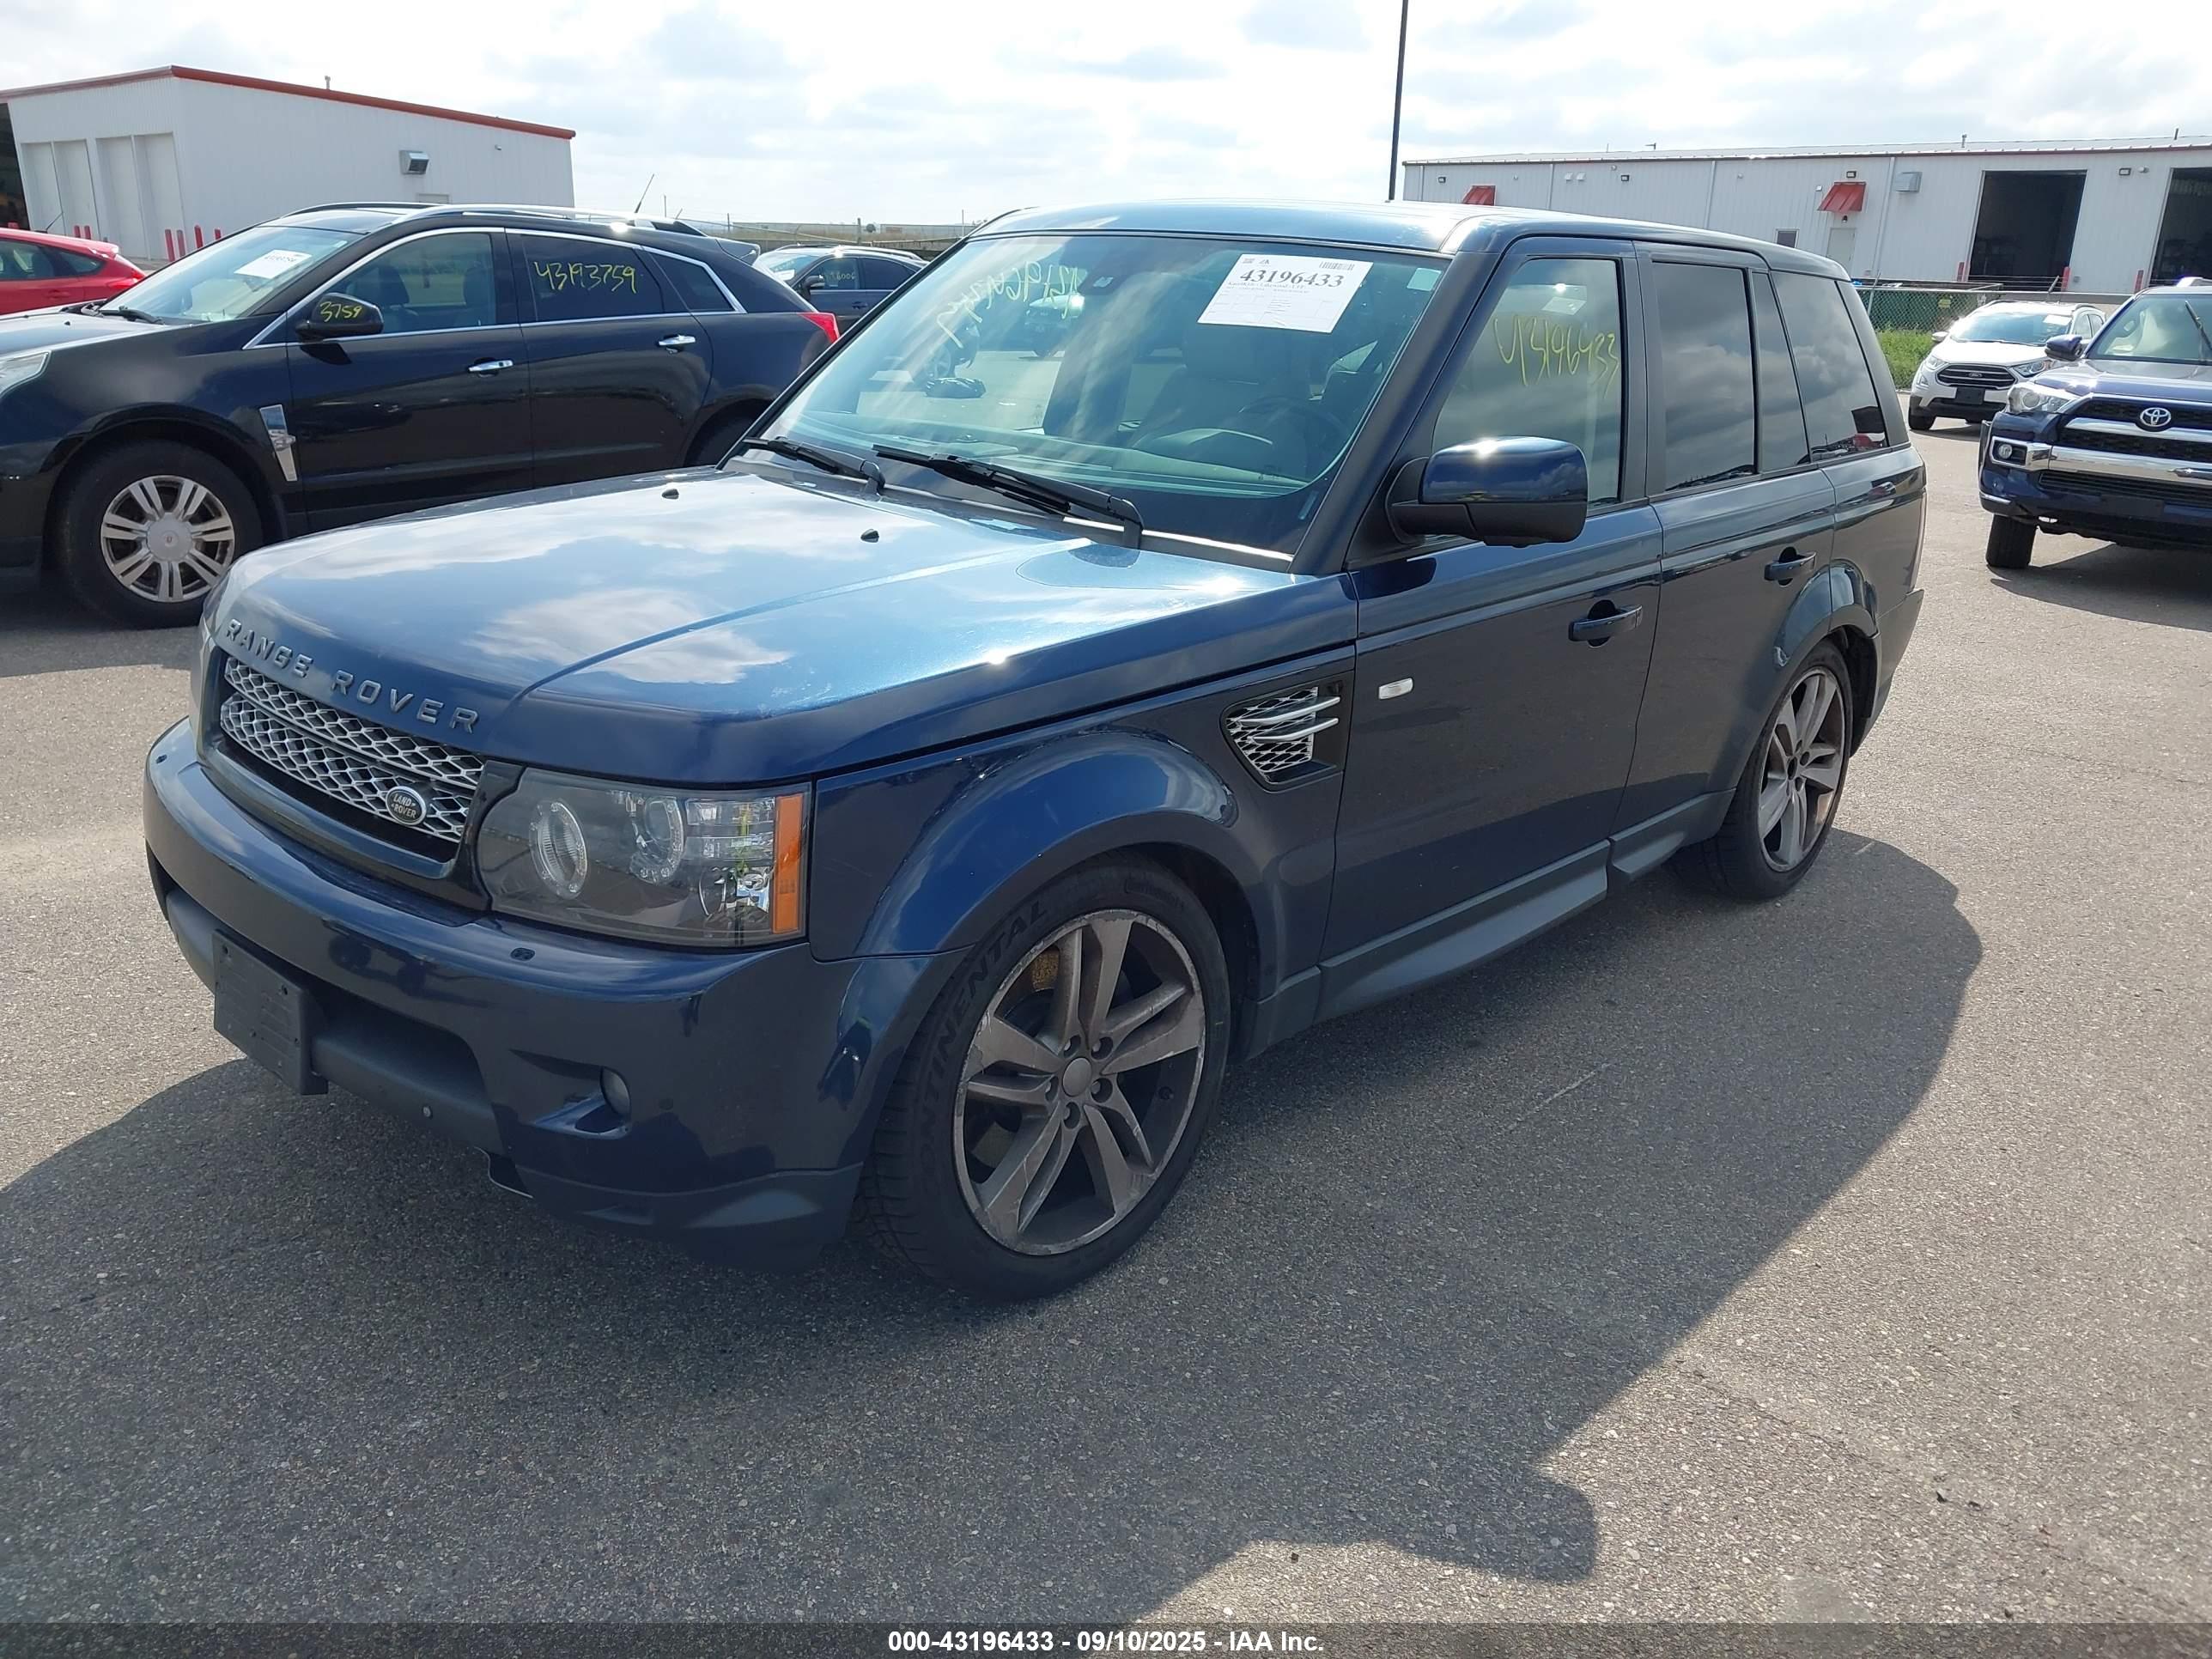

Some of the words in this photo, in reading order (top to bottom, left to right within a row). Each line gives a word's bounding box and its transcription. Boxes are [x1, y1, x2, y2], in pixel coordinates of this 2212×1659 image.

[534, 261, 637, 295] 43193759
[1239, 269, 1345, 288] 43196433
[319, 301, 363, 323] 3759
[1493, 314, 1620, 399] 43196433
[226, 618, 313, 678] RANGE
[331, 670, 479, 734] ROVER
[393, 793, 412, 806] LAND
[394, 803, 416, 818] ROVER
